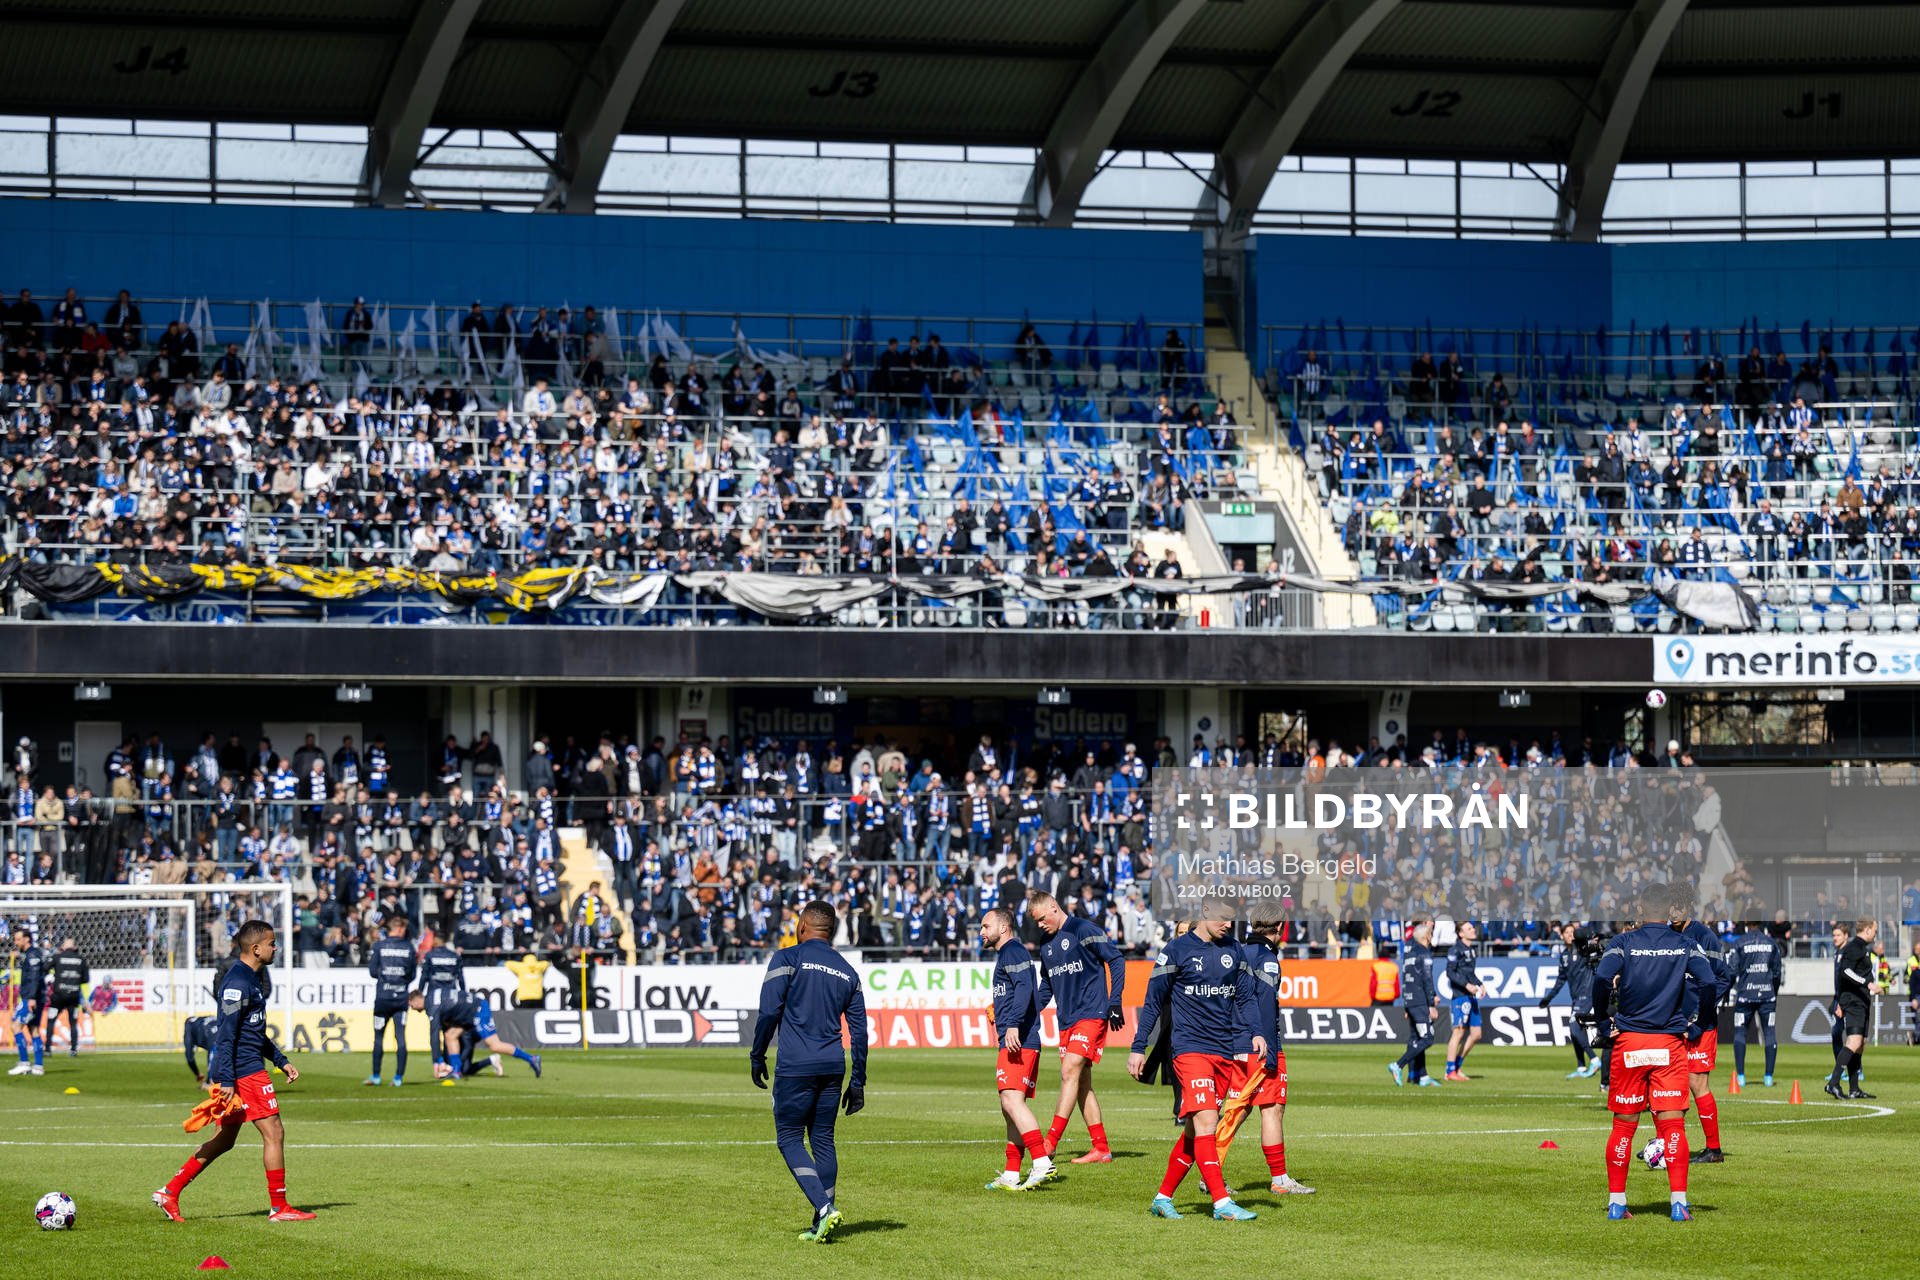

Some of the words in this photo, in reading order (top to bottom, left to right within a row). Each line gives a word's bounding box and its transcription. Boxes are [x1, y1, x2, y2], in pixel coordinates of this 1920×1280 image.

[114, 46, 187, 74] J4
[809, 72, 878, 97] J3
[1392, 91, 1460, 116] J2
[1784, 93, 1840, 118] J1
[1630, 948, 1686, 957] ZINKTEKNIK
[801, 962, 851, 982] ZINKTEKNIK
[635, 975, 719, 1009] law.
[534, 1010, 741, 1044] GUIDE
[1194, 1092, 1206, 1104] 14
